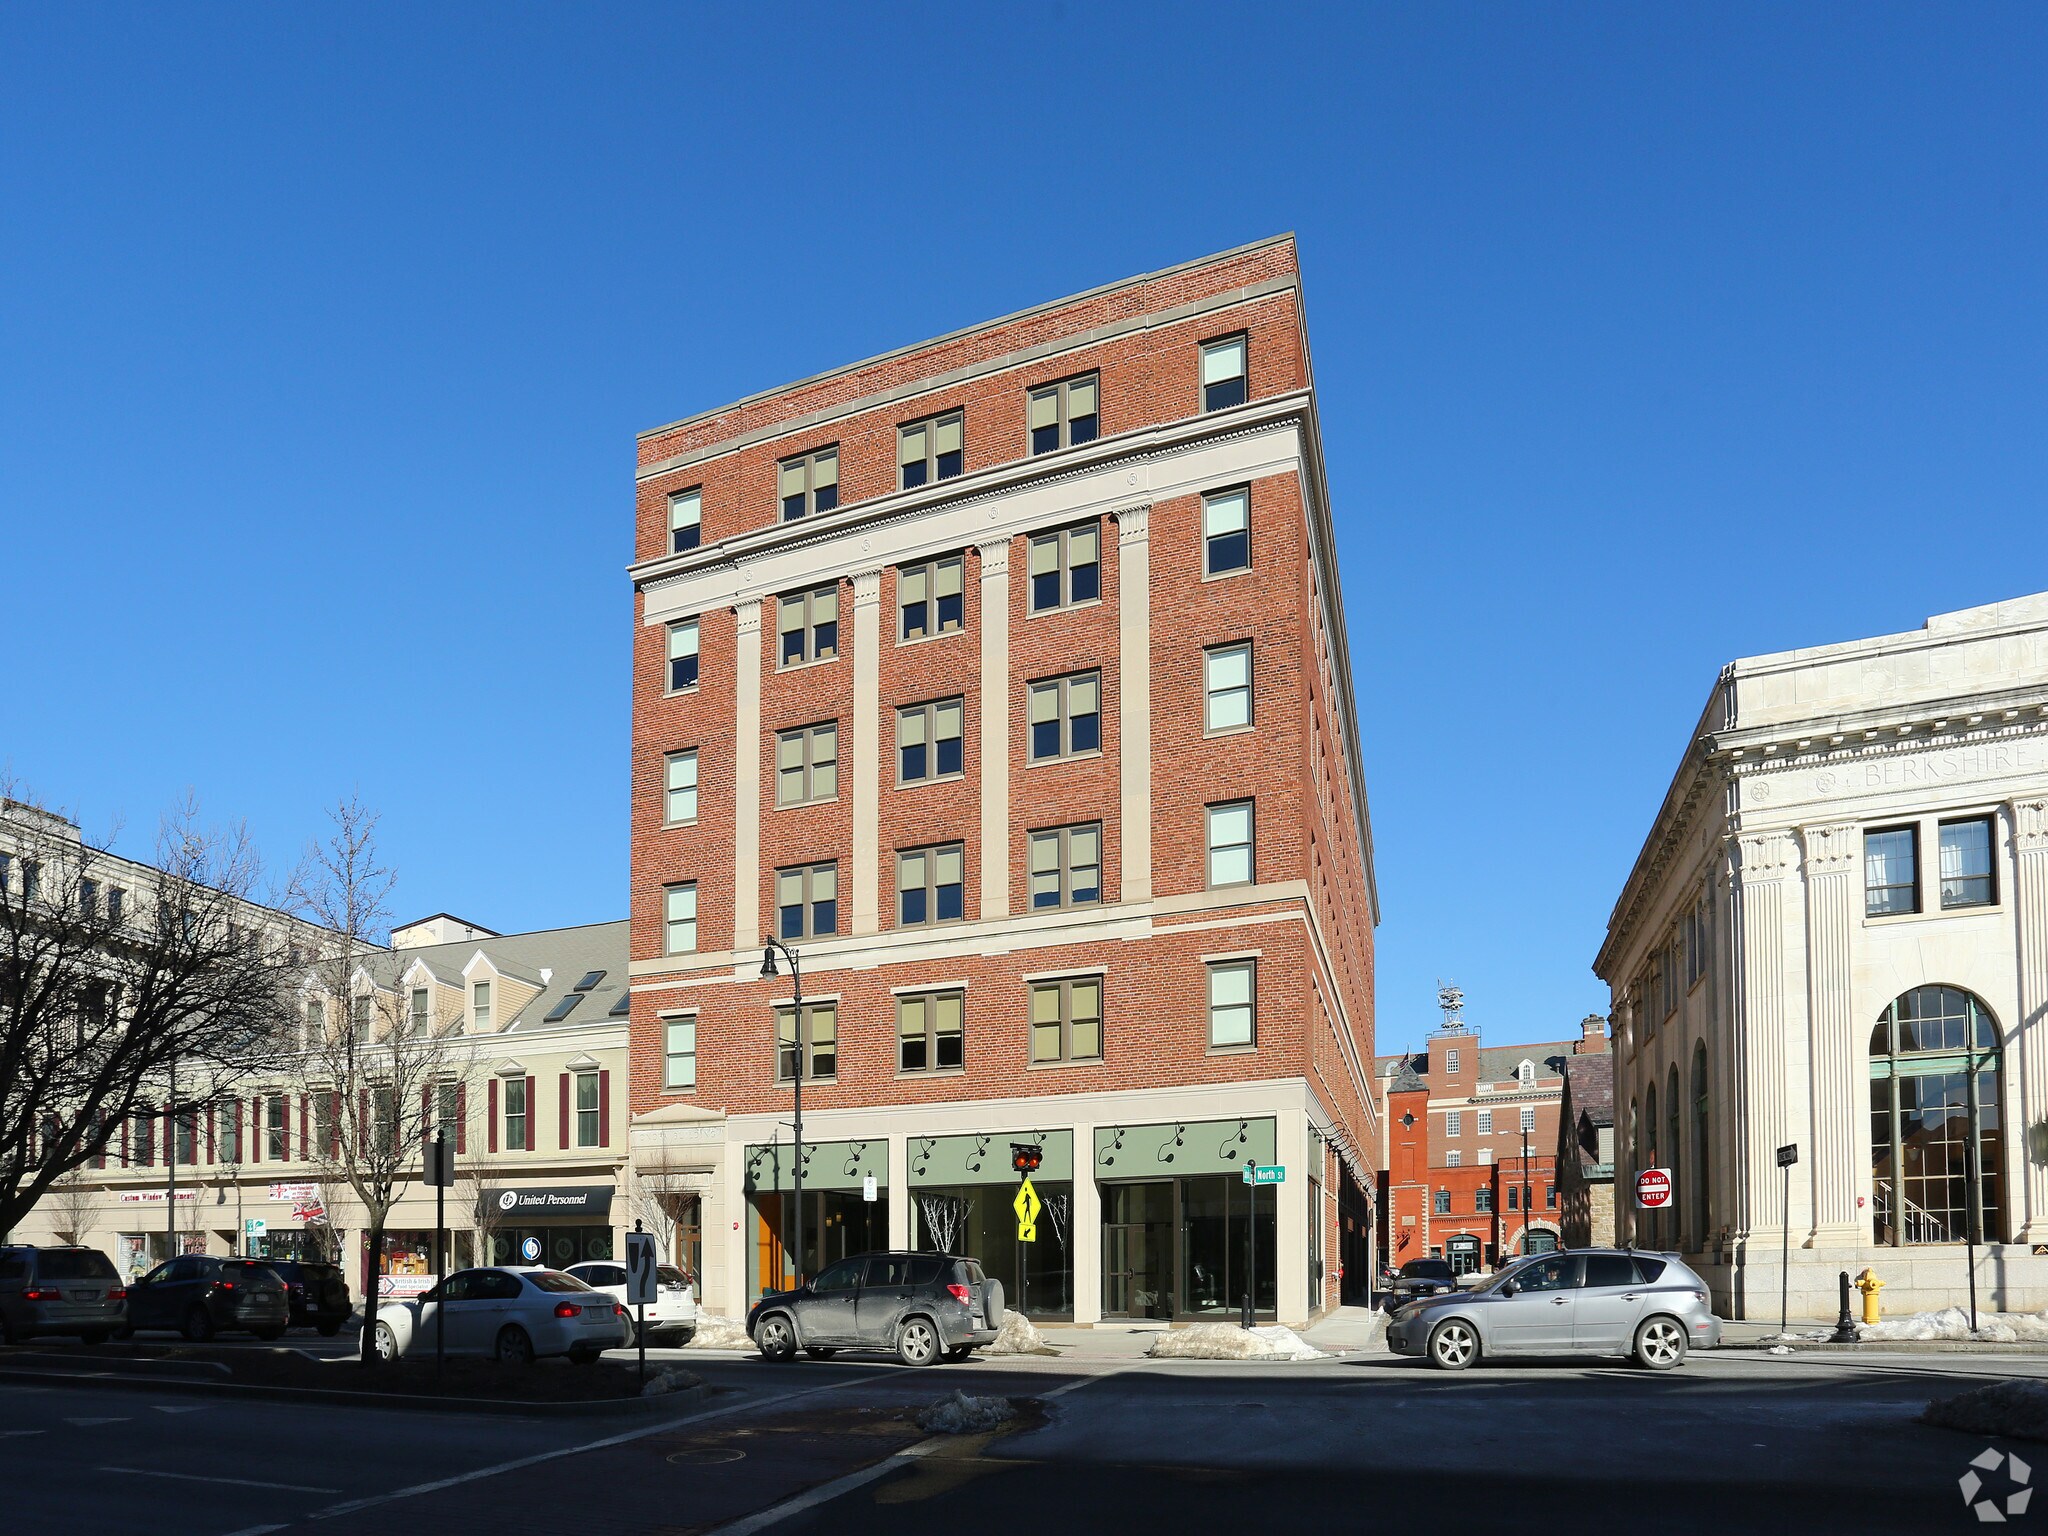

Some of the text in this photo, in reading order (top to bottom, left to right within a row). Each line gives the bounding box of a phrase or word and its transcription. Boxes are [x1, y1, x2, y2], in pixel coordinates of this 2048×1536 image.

[1865, 743, 2034, 788] BERKSHIRE
[1257, 1169, 1276, 1180] North
[1651, 1176, 1666, 1184] NOT
[141, 1193, 163, 1201] Window
[518, 1194, 547, 1206] United
[547, 1193, 588, 1205] Personnel
[1641, 1192, 1665, 1201] ENTER
